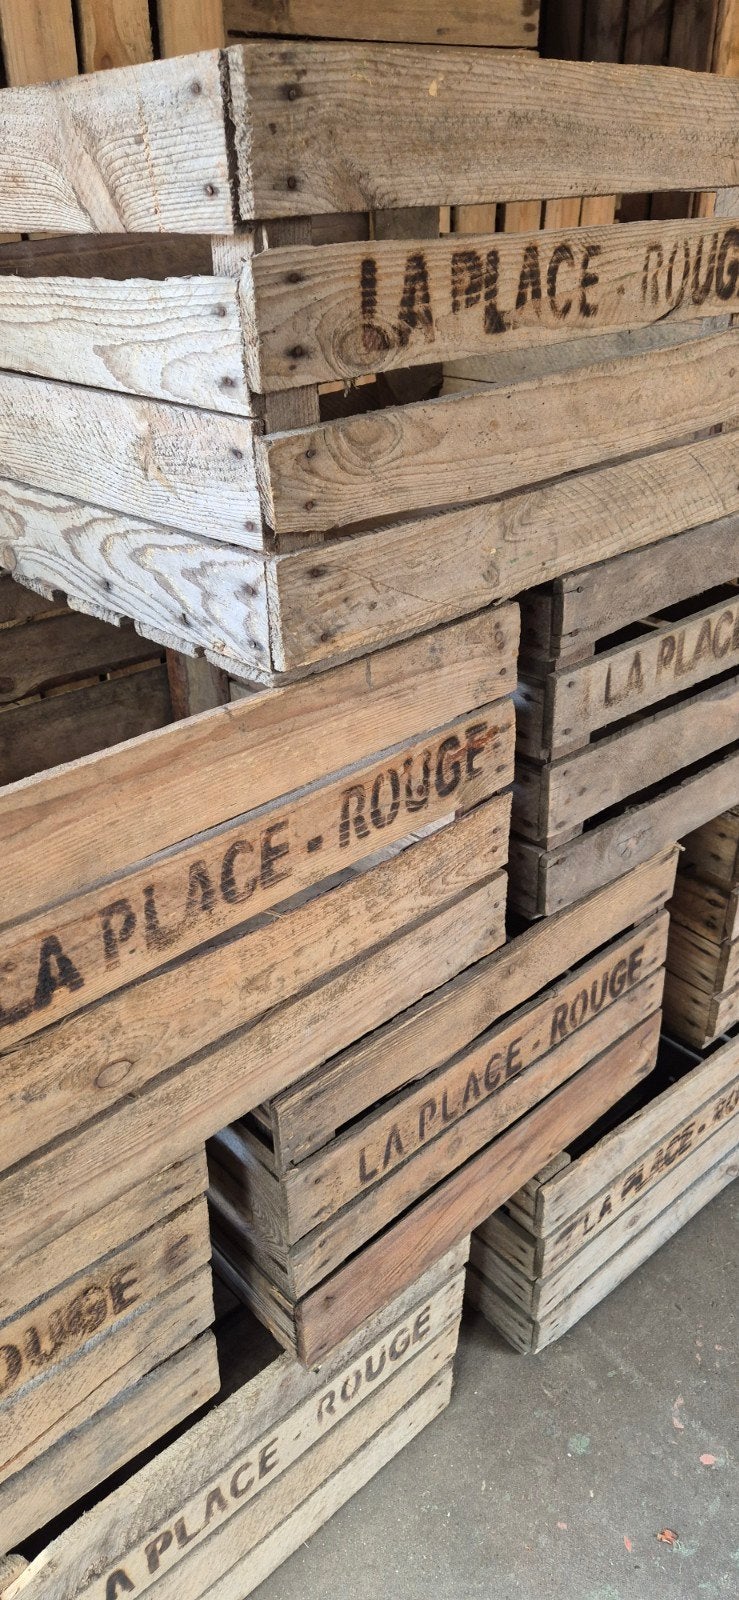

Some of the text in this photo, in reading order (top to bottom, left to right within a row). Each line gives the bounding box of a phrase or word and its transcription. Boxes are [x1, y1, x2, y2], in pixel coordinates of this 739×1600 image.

[359, 253, 435, 352] LA
[450, 242, 601, 335] PLACE
[639, 227, 739, 305] ROUG
[602, 649, 644, 709] LA
[99, 816, 292, 972] PLACE
[339, 722, 488, 847] ROUGE
[358, 1122, 405, 1184] LA
[416, 1034, 524, 1142] PLACE
[550, 945, 645, 1045] ROUGE
[582, 1193, 613, 1236] LA
[143, 1436, 280, 1575] PLACE
[315, 1305, 433, 1423] ROUGE
